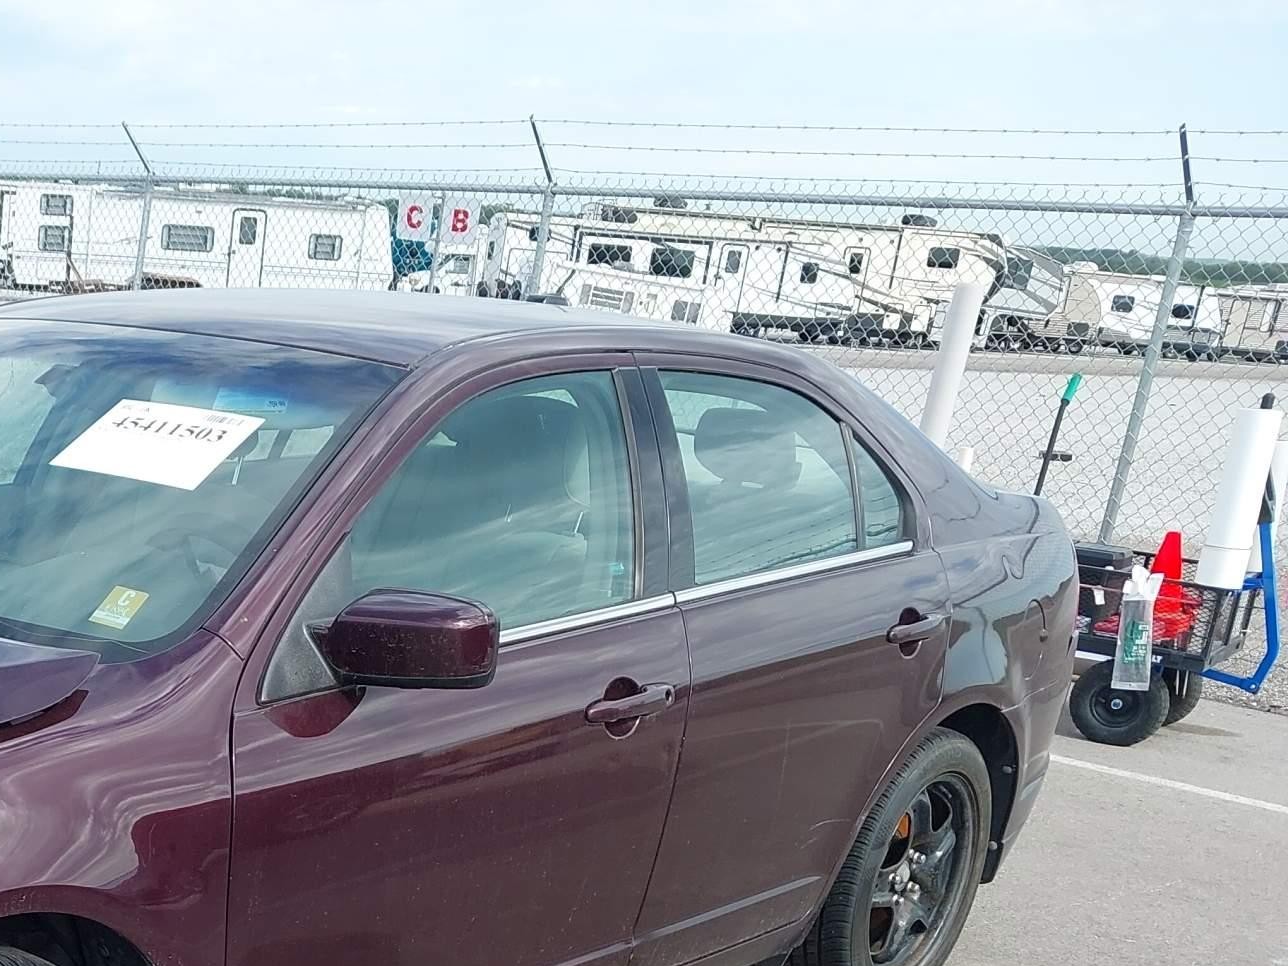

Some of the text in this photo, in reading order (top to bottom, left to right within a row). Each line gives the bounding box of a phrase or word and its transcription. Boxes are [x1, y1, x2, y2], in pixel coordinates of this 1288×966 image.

[406, 204, 424, 230] C
[450, 208, 470, 233] B
[111, 415, 228, 444] 45411503
